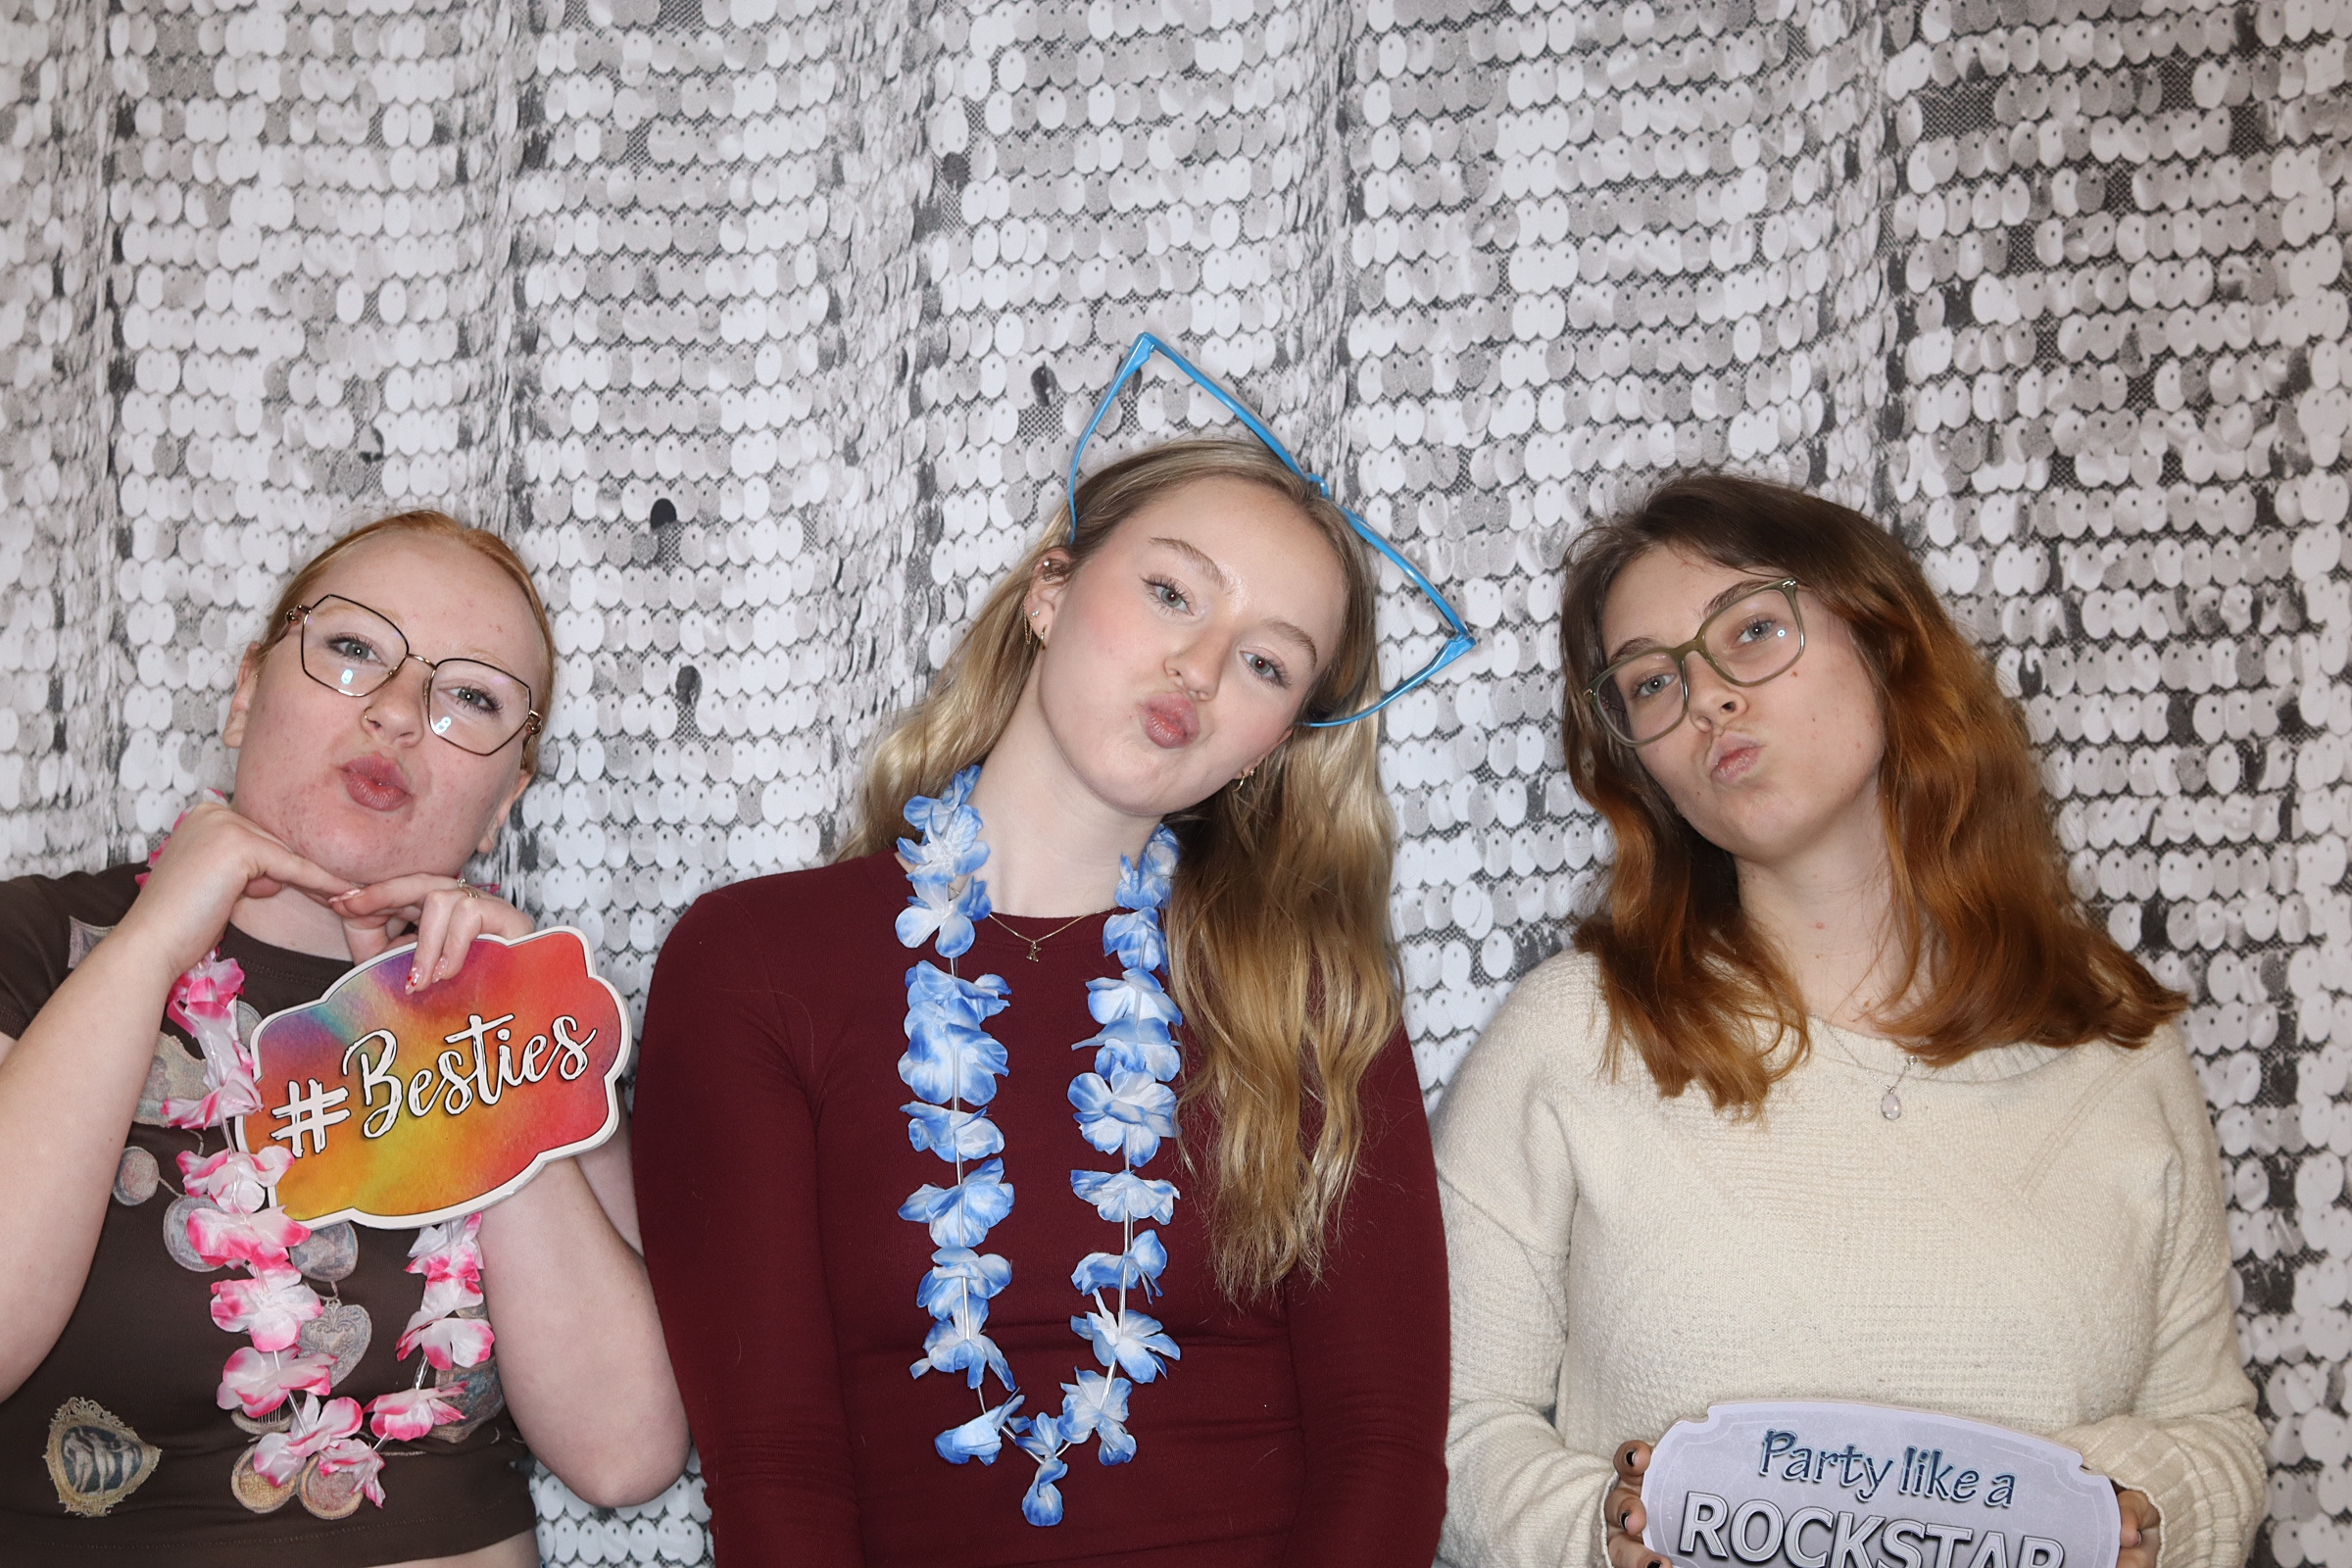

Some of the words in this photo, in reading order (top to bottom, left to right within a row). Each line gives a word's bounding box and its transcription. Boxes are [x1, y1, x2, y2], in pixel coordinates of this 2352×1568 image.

[270, 1014, 597, 1157] #Besties
[1759, 1429, 1894, 1501] Party
[1899, 1446, 1981, 1503] like
[1984, 1471, 2018, 1508] a
